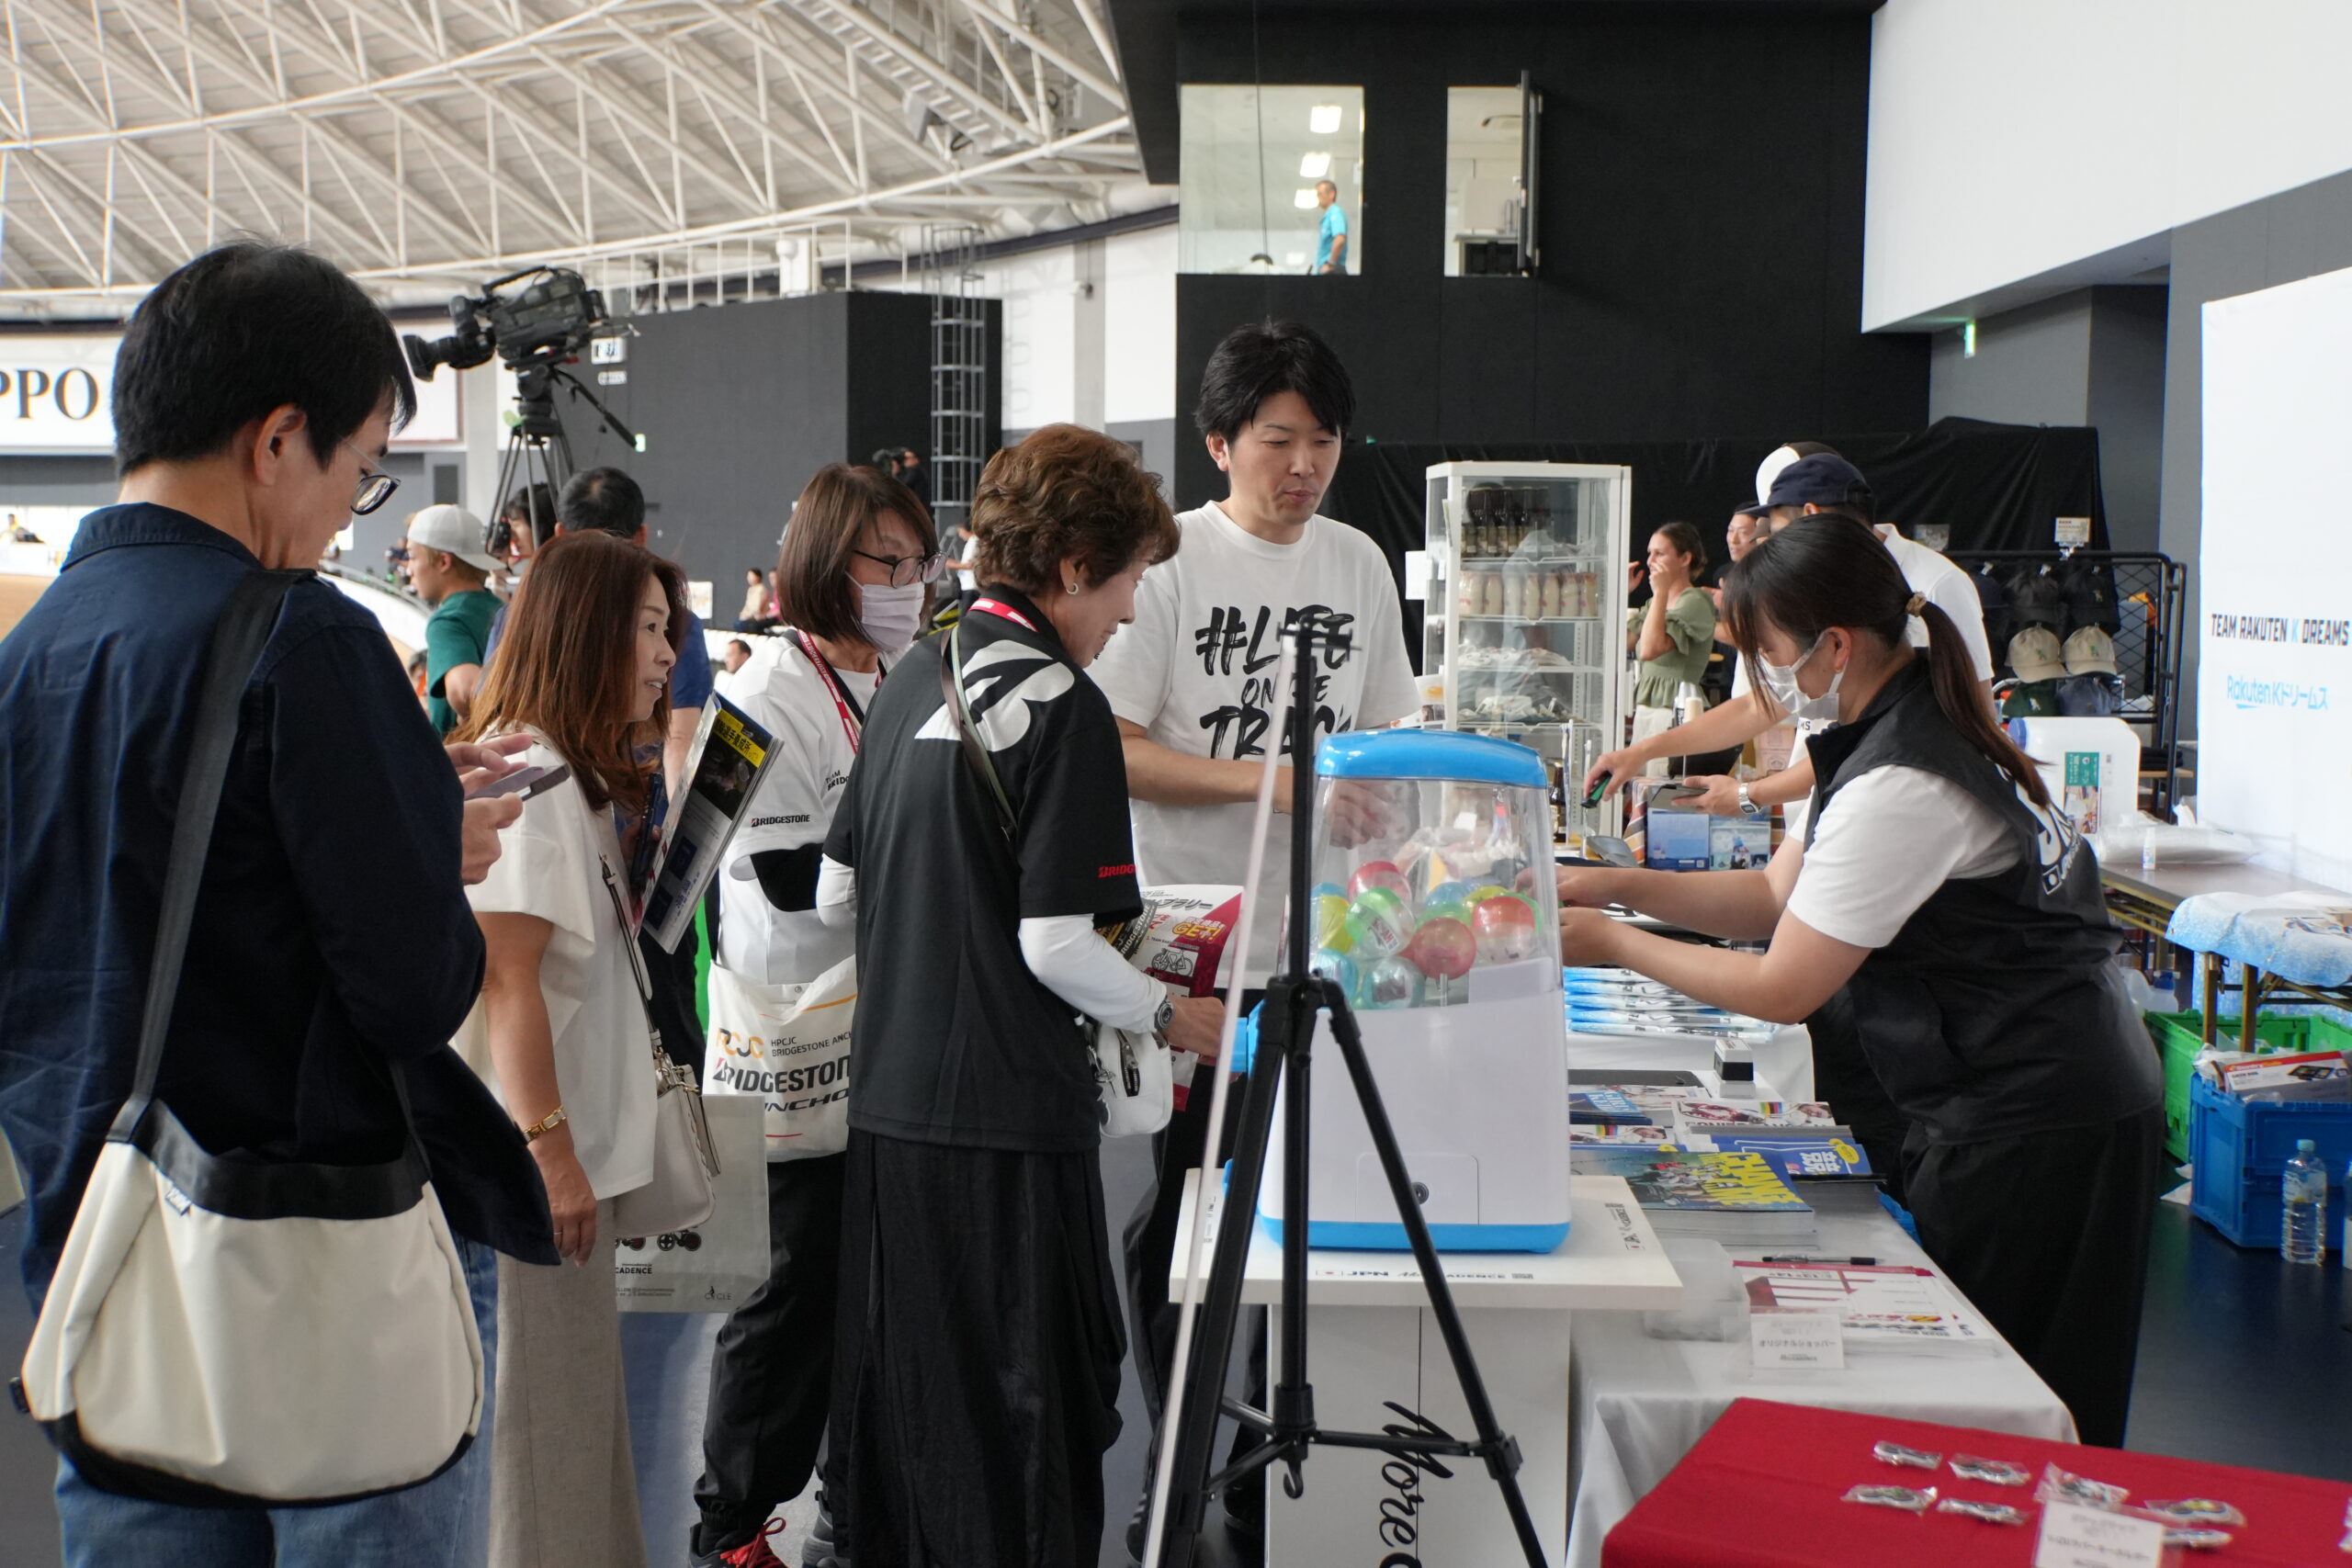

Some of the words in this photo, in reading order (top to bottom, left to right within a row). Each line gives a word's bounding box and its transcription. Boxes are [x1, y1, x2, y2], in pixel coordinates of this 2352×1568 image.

[2211, 613, 2237, 638] TEAM
[2239, 615, 2288, 642] RAKUTEN
[2301, 618, 2350, 647] DREAMS
[2227, 674, 2271, 709] Rakuten
[751, 815, 810, 828] BRIDGESTONE
[1172, 921, 1222, 942] GET!
[771, 1036, 797, 1047] HPCJC
[772, 1040, 831, 1057] BRIDGESTONE
[764, 1088, 850, 1111] NCHO
[1379, 1401, 1454, 1548] More
